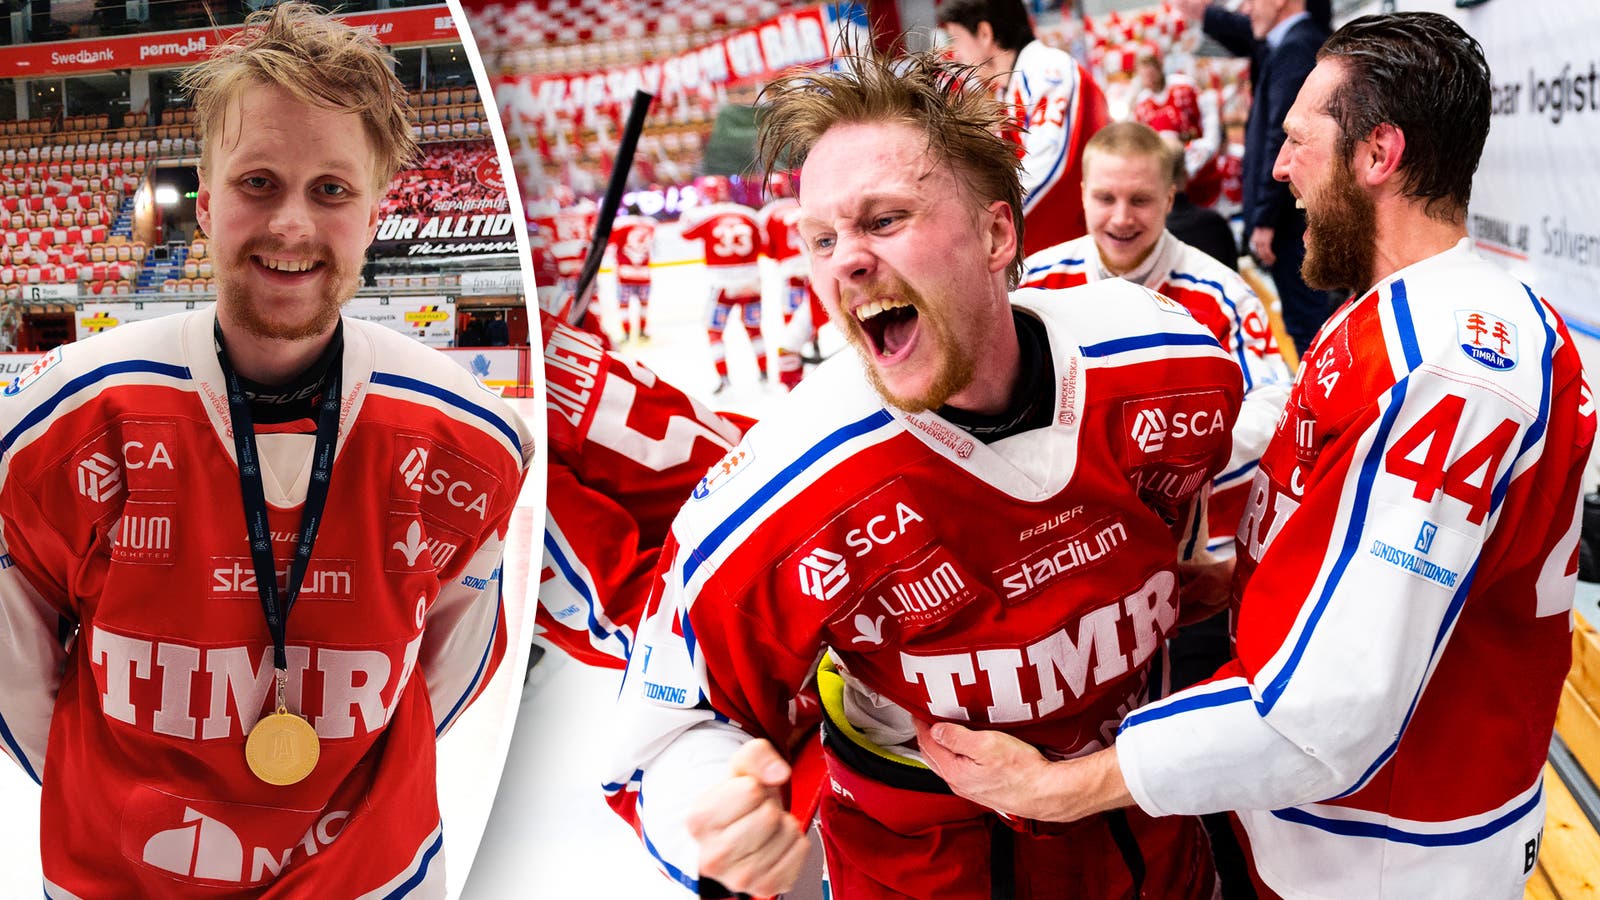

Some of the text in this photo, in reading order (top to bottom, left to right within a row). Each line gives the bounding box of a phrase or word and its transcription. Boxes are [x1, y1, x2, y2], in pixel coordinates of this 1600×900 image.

[51, 49, 114, 65] Swedbank
[140, 36, 206, 60] permobil
[376, 213, 514, 241] ÖR ALLTID
[712, 224, 753, 257] 33
[1061, 376, 1069, 408] HOCKEY
[1068, 356, 1078, 410] ALLSVENSKAN
[904, 414, 956, 450] ALLSVENSKAN
[1171, 408, 1225, 439] SCA
[1385, 393, 1521, 526] 44
[425, 469, 488, 521] SCA
[846, 502, 924, 558] SCA
[1019, 505, 1084, 542] BAUER
[1003, 522, 1128, 599] stadium
[877, 561, 965, 616] LILIUM
[900, 570, 1177, 725] TIMR
[643, 681, 687, 705] TIDNING
